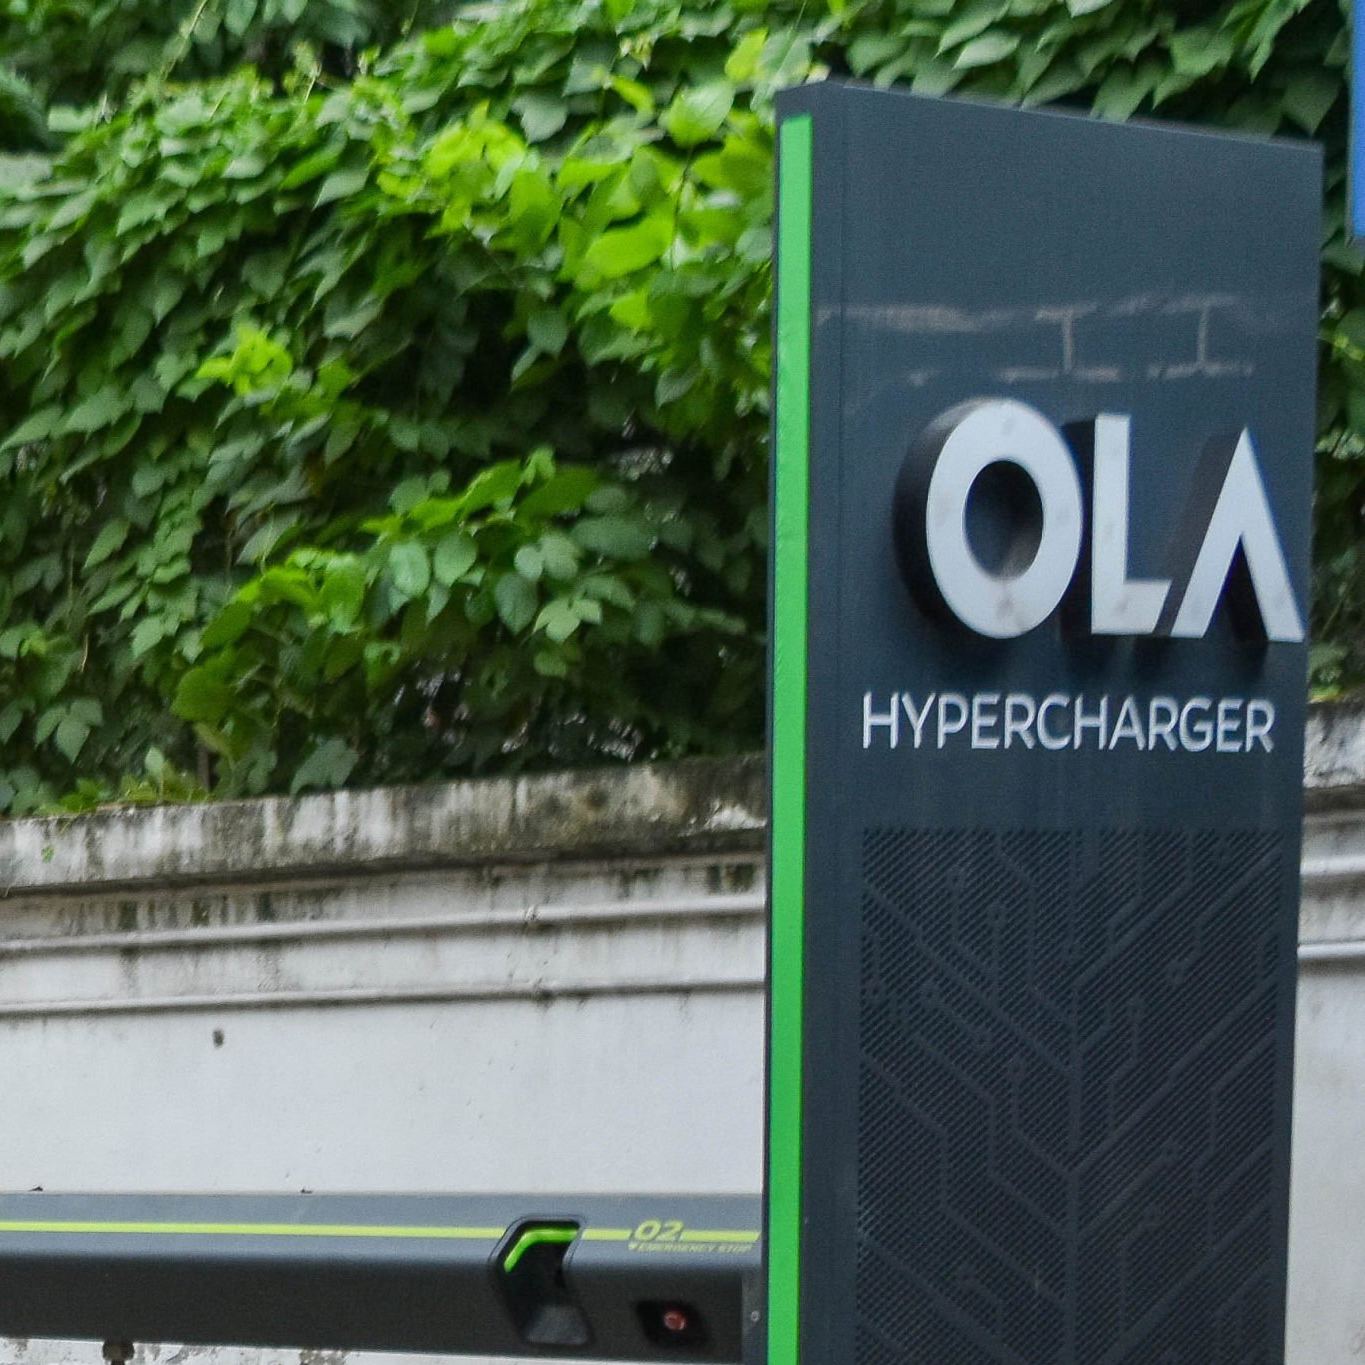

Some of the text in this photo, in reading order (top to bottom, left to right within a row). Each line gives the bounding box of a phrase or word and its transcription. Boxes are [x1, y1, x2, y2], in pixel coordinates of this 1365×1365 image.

[924, 396, 1306, 643] OLA
[861, 690, 1276, 754] HYPERCHARGER
[634, 1218, 684, 1242] 02
